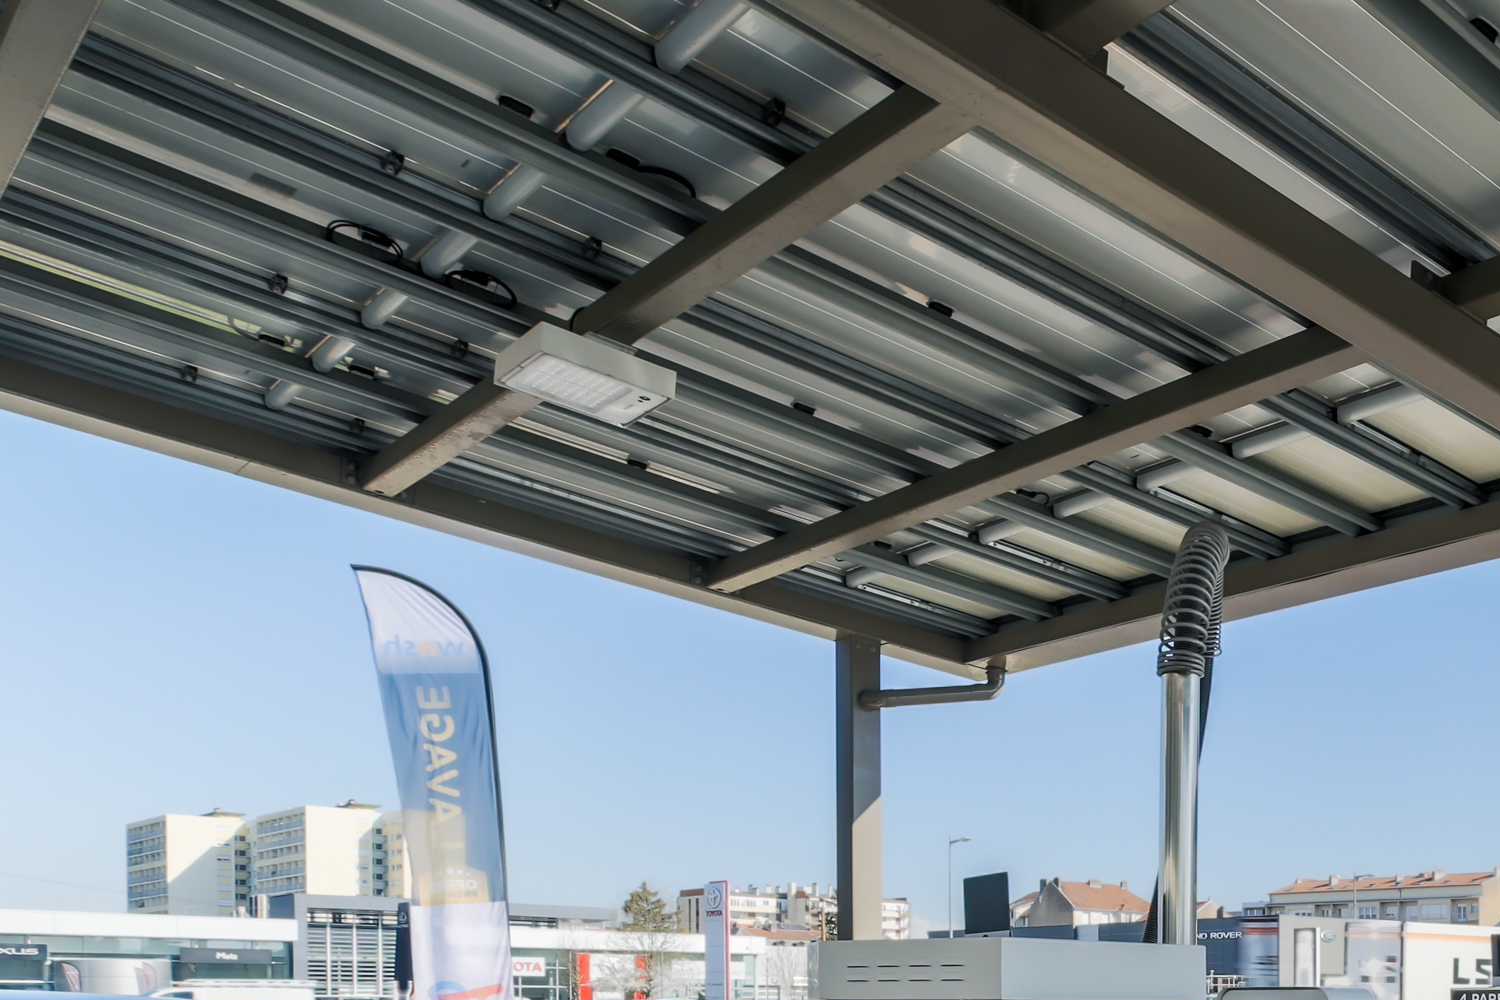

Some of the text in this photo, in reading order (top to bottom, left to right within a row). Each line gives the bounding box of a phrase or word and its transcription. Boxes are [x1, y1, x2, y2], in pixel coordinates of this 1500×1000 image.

[705, 910, 723, 918] TOYOTA
[1210, 931, 1243, 940] ROVER
[513, 961, 542, 972] OTA
